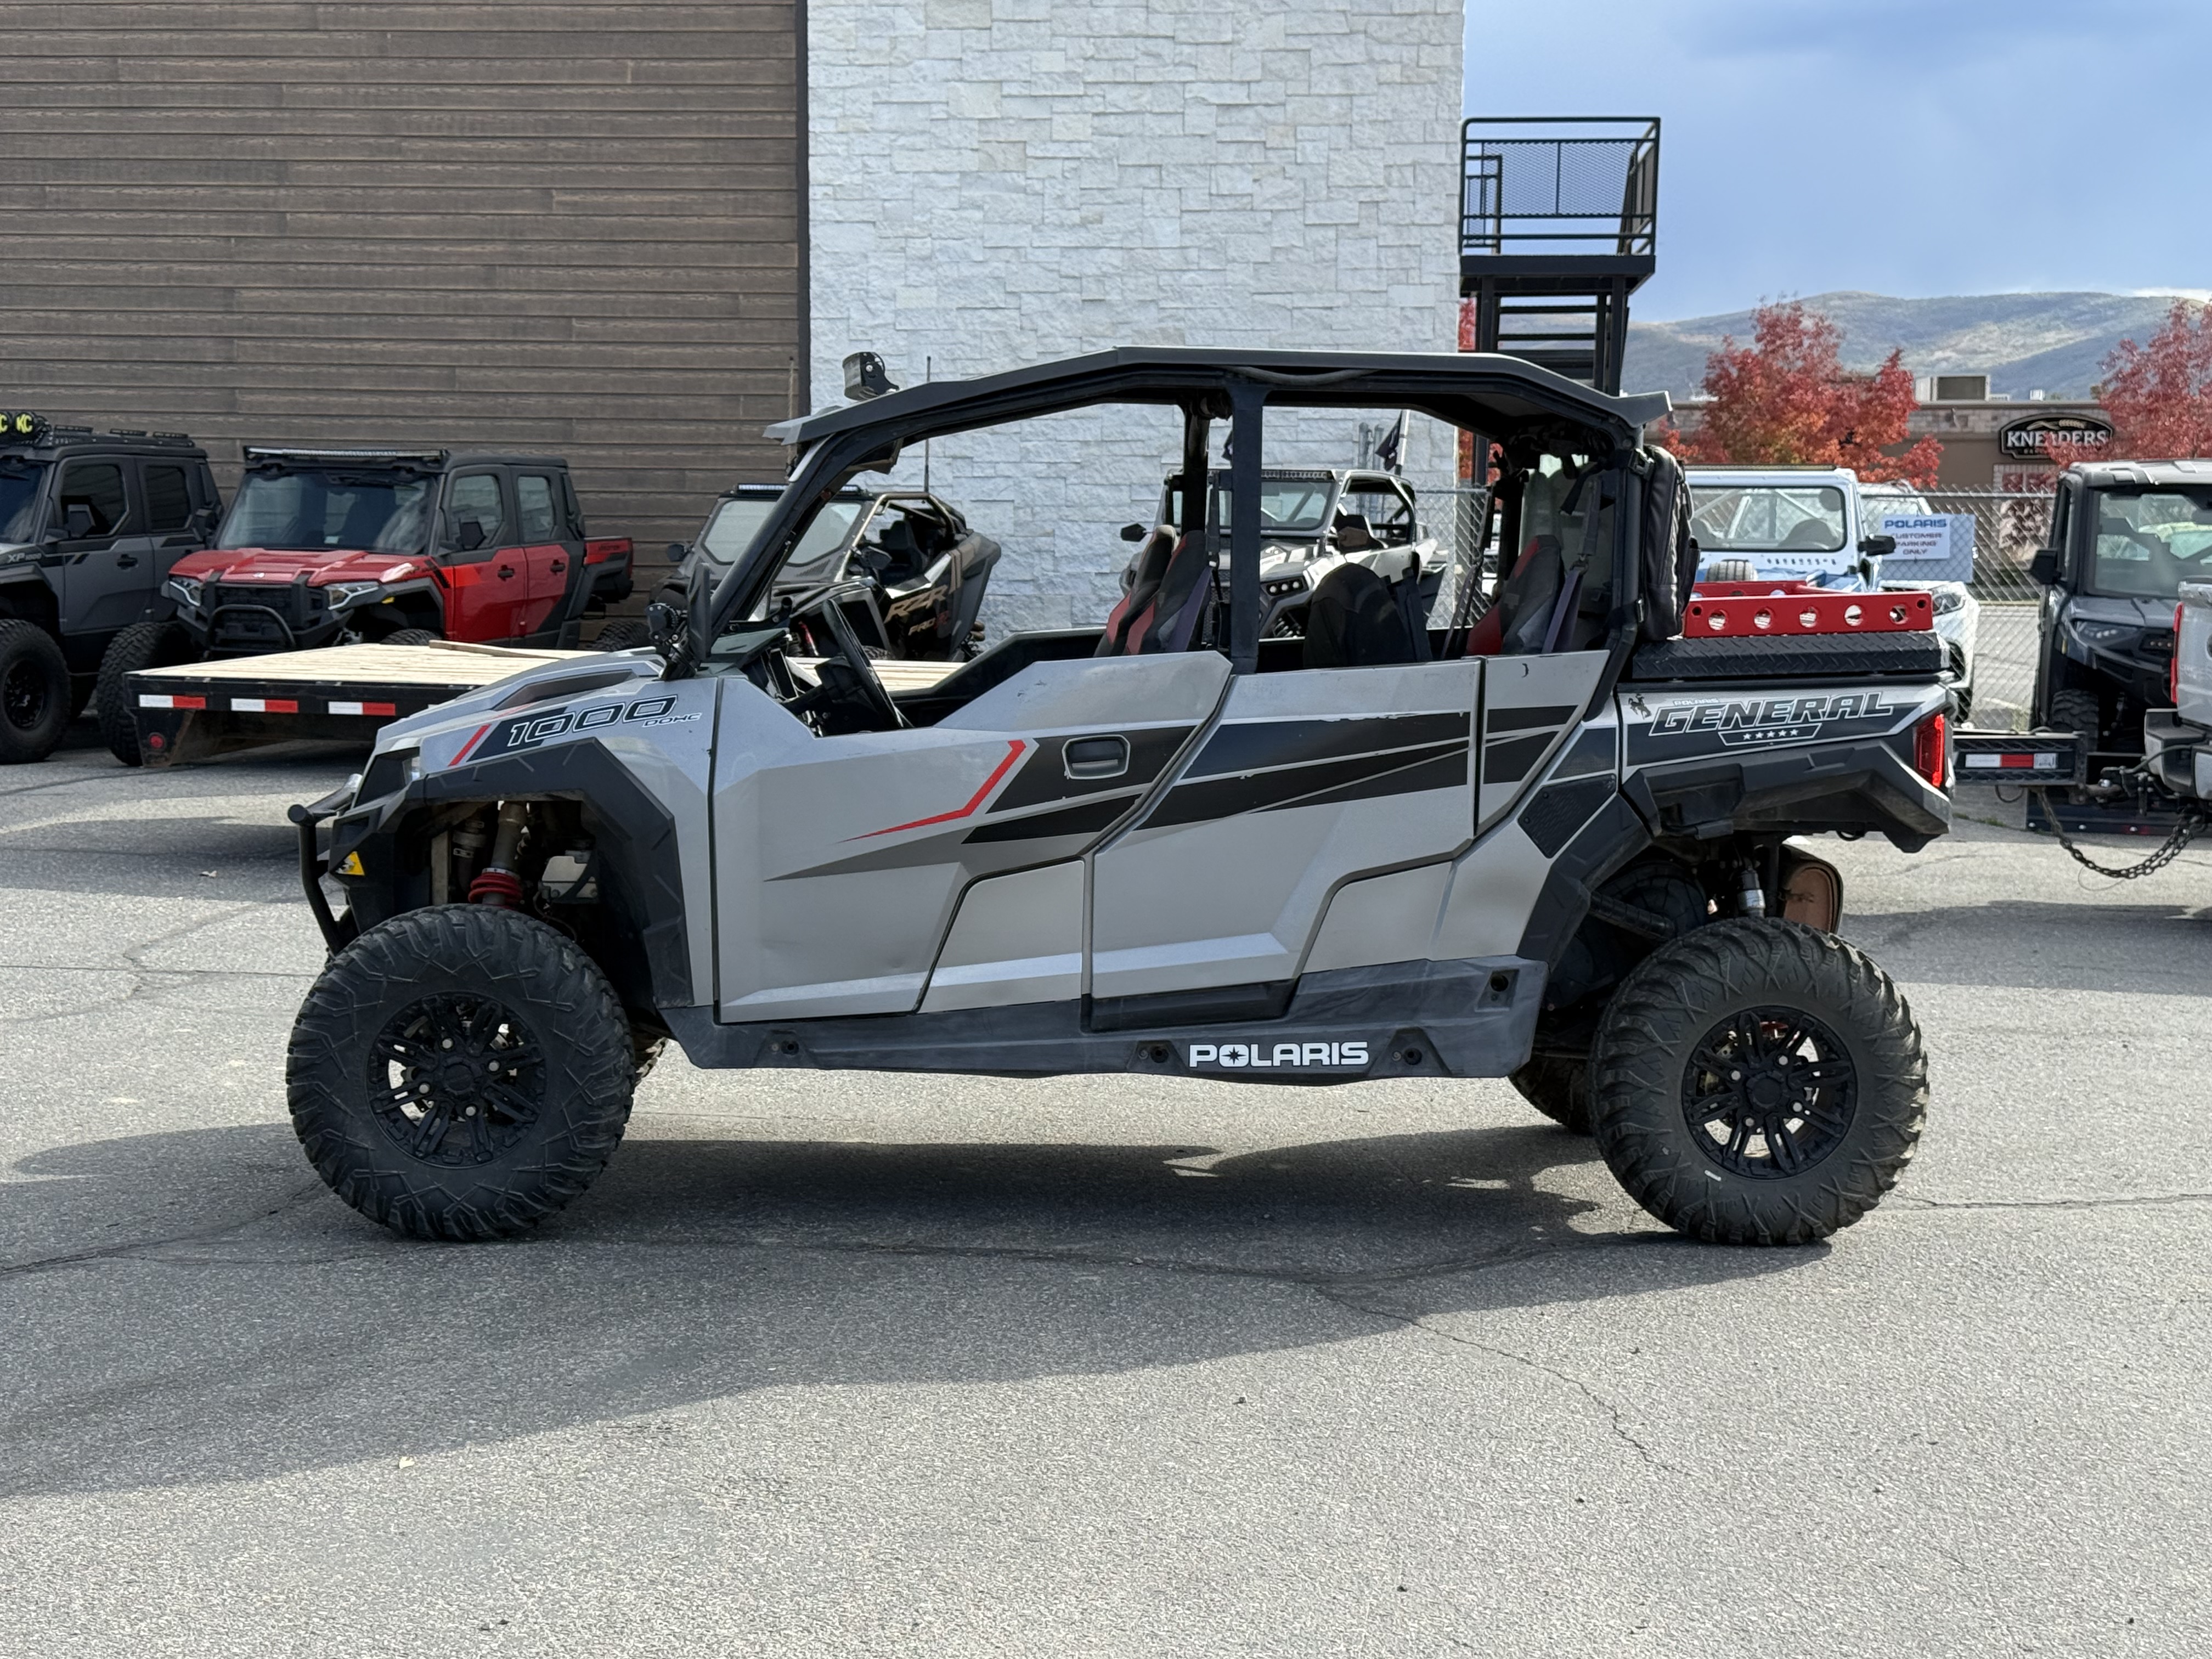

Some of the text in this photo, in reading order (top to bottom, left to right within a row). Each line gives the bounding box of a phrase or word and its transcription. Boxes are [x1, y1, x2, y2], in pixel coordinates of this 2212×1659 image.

[0, 414, 8, 433] C
[16, 414, 33, 433] KC
[1884, 518, 1946, 528] POLARIS
[7, 552, 25, 563] XP
[883, 584, 948, 624] RZR
[908, 617, 936, 636] PRO
[507, 695, 702, 747] 1000 DOHC
[1648, 691, 1893, 736] GENERAL
[1189, 1041, 1369, 1068] POLARIS
